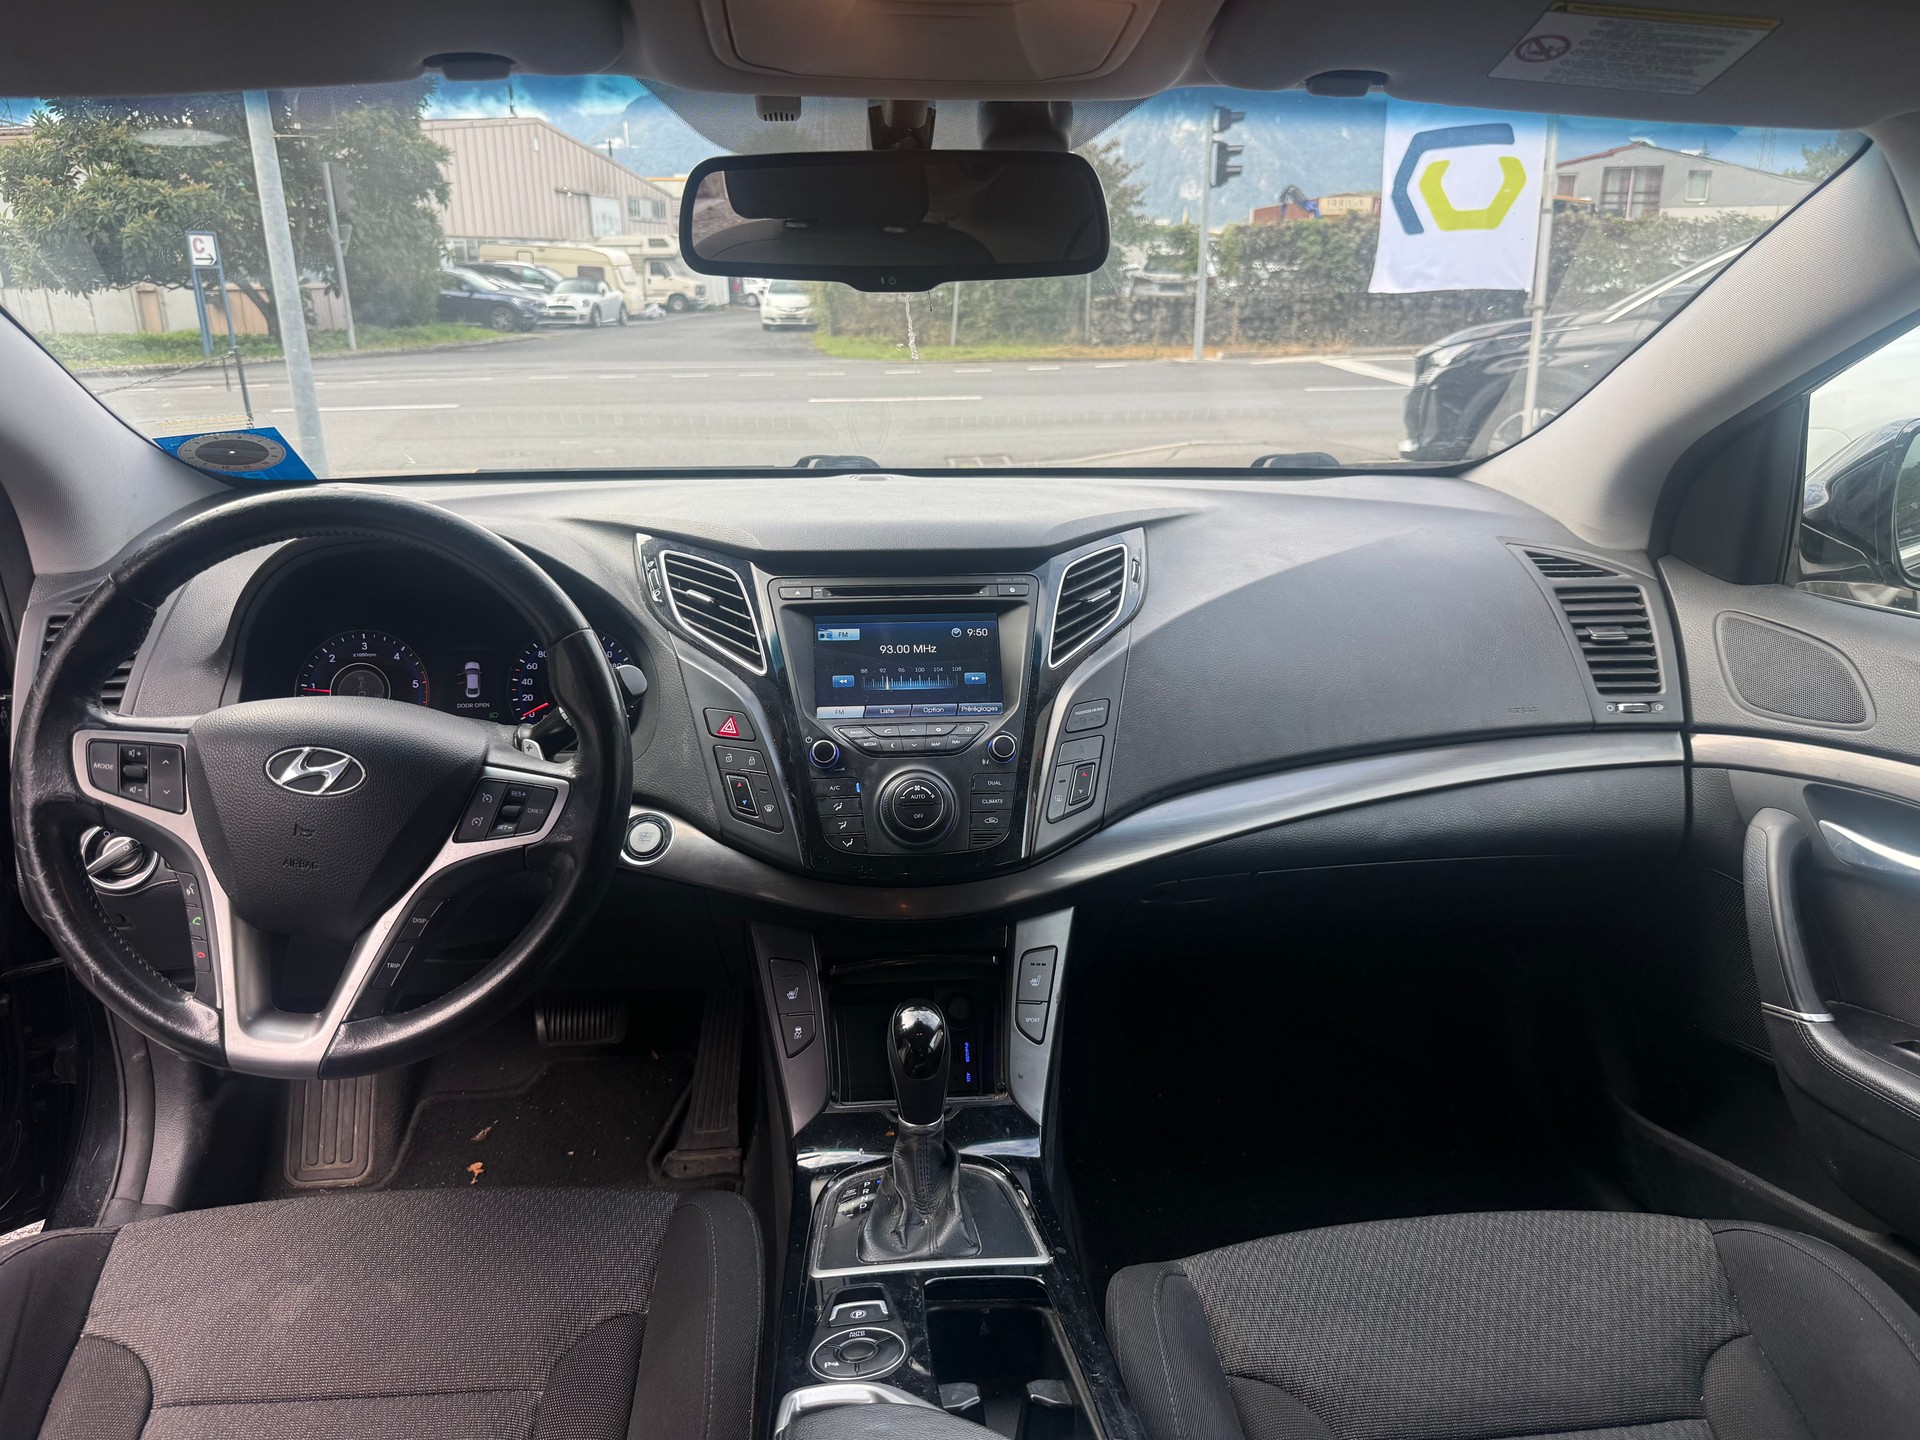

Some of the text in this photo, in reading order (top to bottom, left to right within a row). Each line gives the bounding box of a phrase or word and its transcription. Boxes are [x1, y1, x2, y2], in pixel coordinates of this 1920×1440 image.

[192, 237, 205, 254] C
[966, 628, 989, 637] 9:50
[361, 642, 368, 650] 3
[879, 644, 937, 654] 93.00 MHz
[328, 654, 336, 663] 2
[393, 653, 400, 661] 4
[526, 662, 538, 670] 60
[412, 680, 419, 688] 5
[521, 678, 533, 686] 40
[522, 694, 534, 702] 20
[922, 706, 945, 715] Option
[961, 705, 999, 714] Préréglages
[93, 762, 115, 771] MODE
[282, 859, 320, 869] AIRBAG
